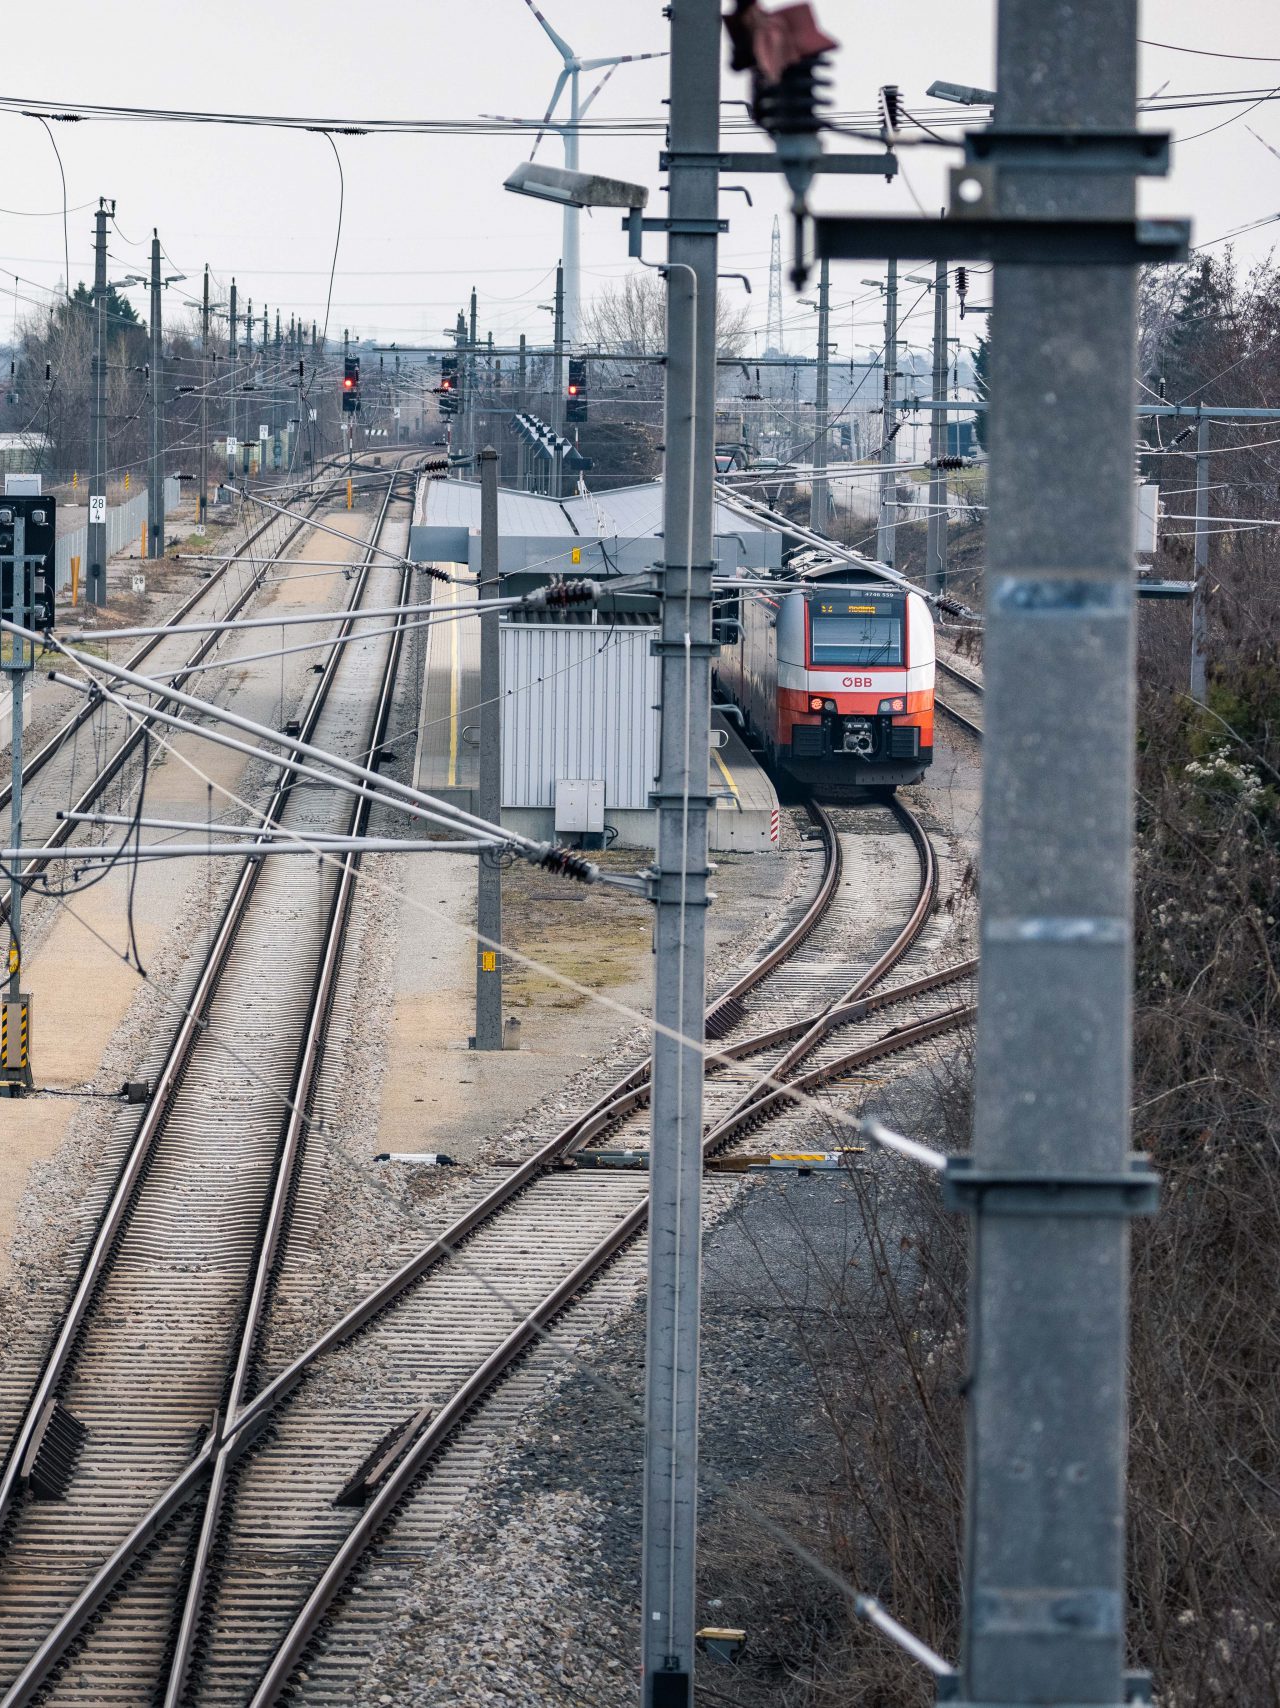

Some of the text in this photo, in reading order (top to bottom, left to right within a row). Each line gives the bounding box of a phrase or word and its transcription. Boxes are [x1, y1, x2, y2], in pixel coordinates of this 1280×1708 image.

[92, 498, 104, 509] 28
[95, 510, 101, 521] 4
[134, 576, 144, 585] 28
[842, 677, 872, 688] ÖBB
